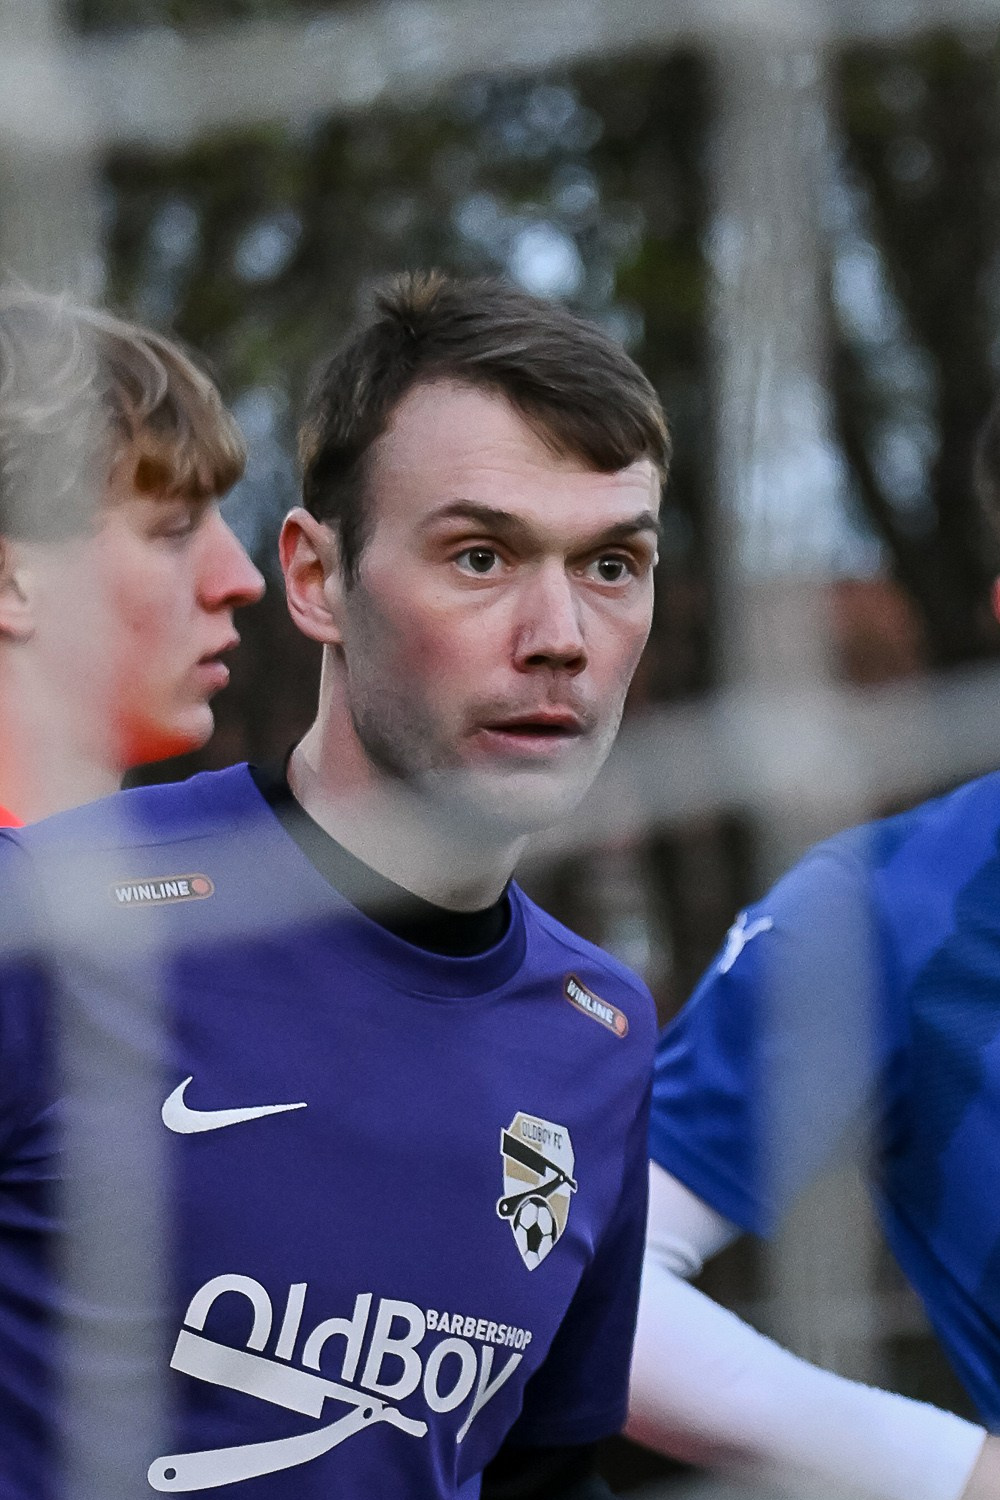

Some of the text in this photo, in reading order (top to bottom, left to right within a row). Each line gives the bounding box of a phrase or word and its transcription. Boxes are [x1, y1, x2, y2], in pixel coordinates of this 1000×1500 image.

[115, 881, 190, 902] WINLINE
[566, 979, 614, 1025] WINLINE
[426, 1308, 533, 1351] BARBERSHOP
